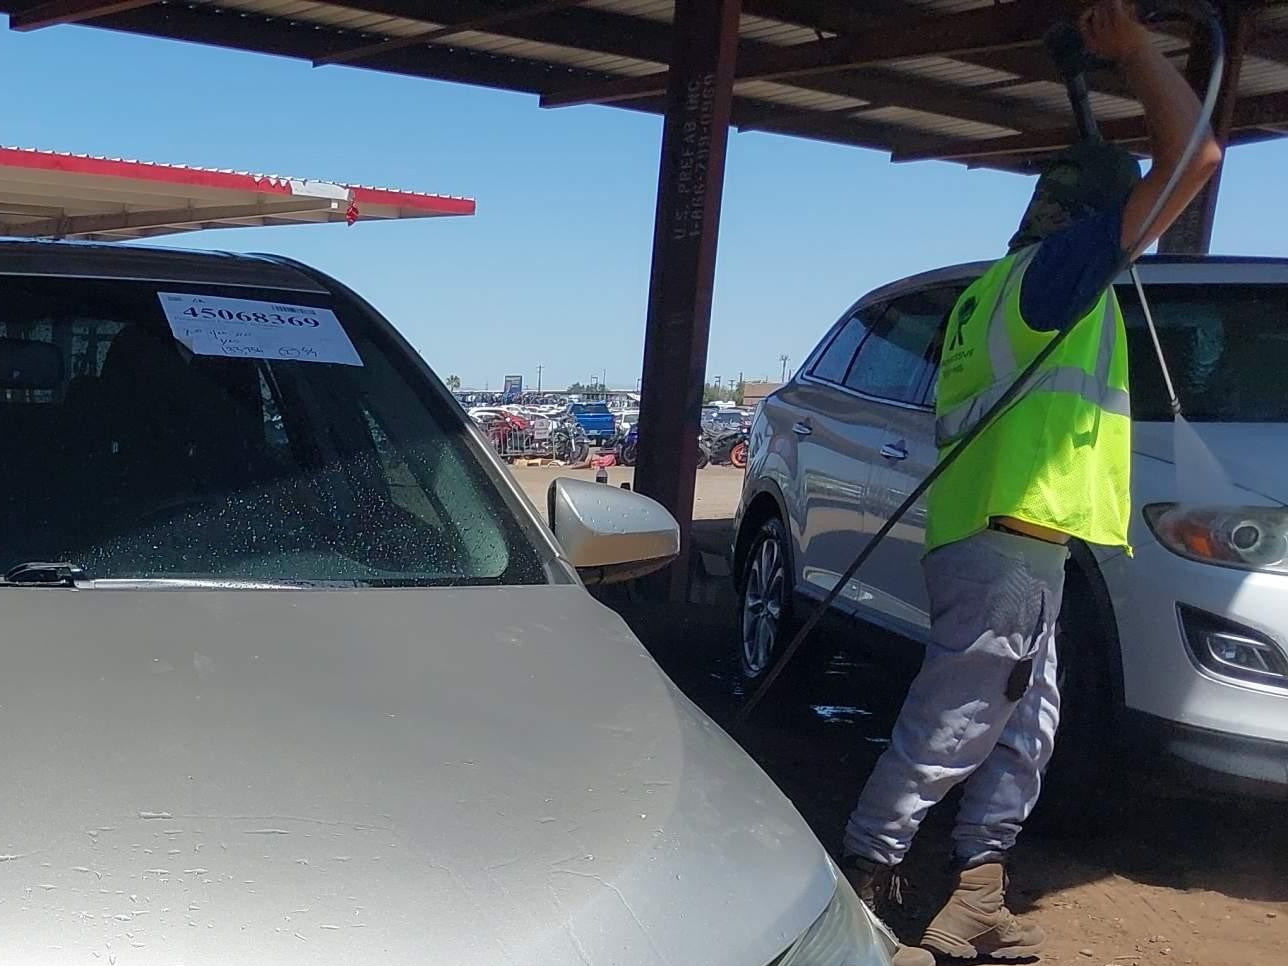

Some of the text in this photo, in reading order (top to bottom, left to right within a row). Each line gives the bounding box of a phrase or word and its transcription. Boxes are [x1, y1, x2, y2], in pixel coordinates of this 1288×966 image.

[677, 120, 697, 194] PREFAB
[673, 204, 689, 241] U.S.
[183, 306, 320, 328] 45068369
